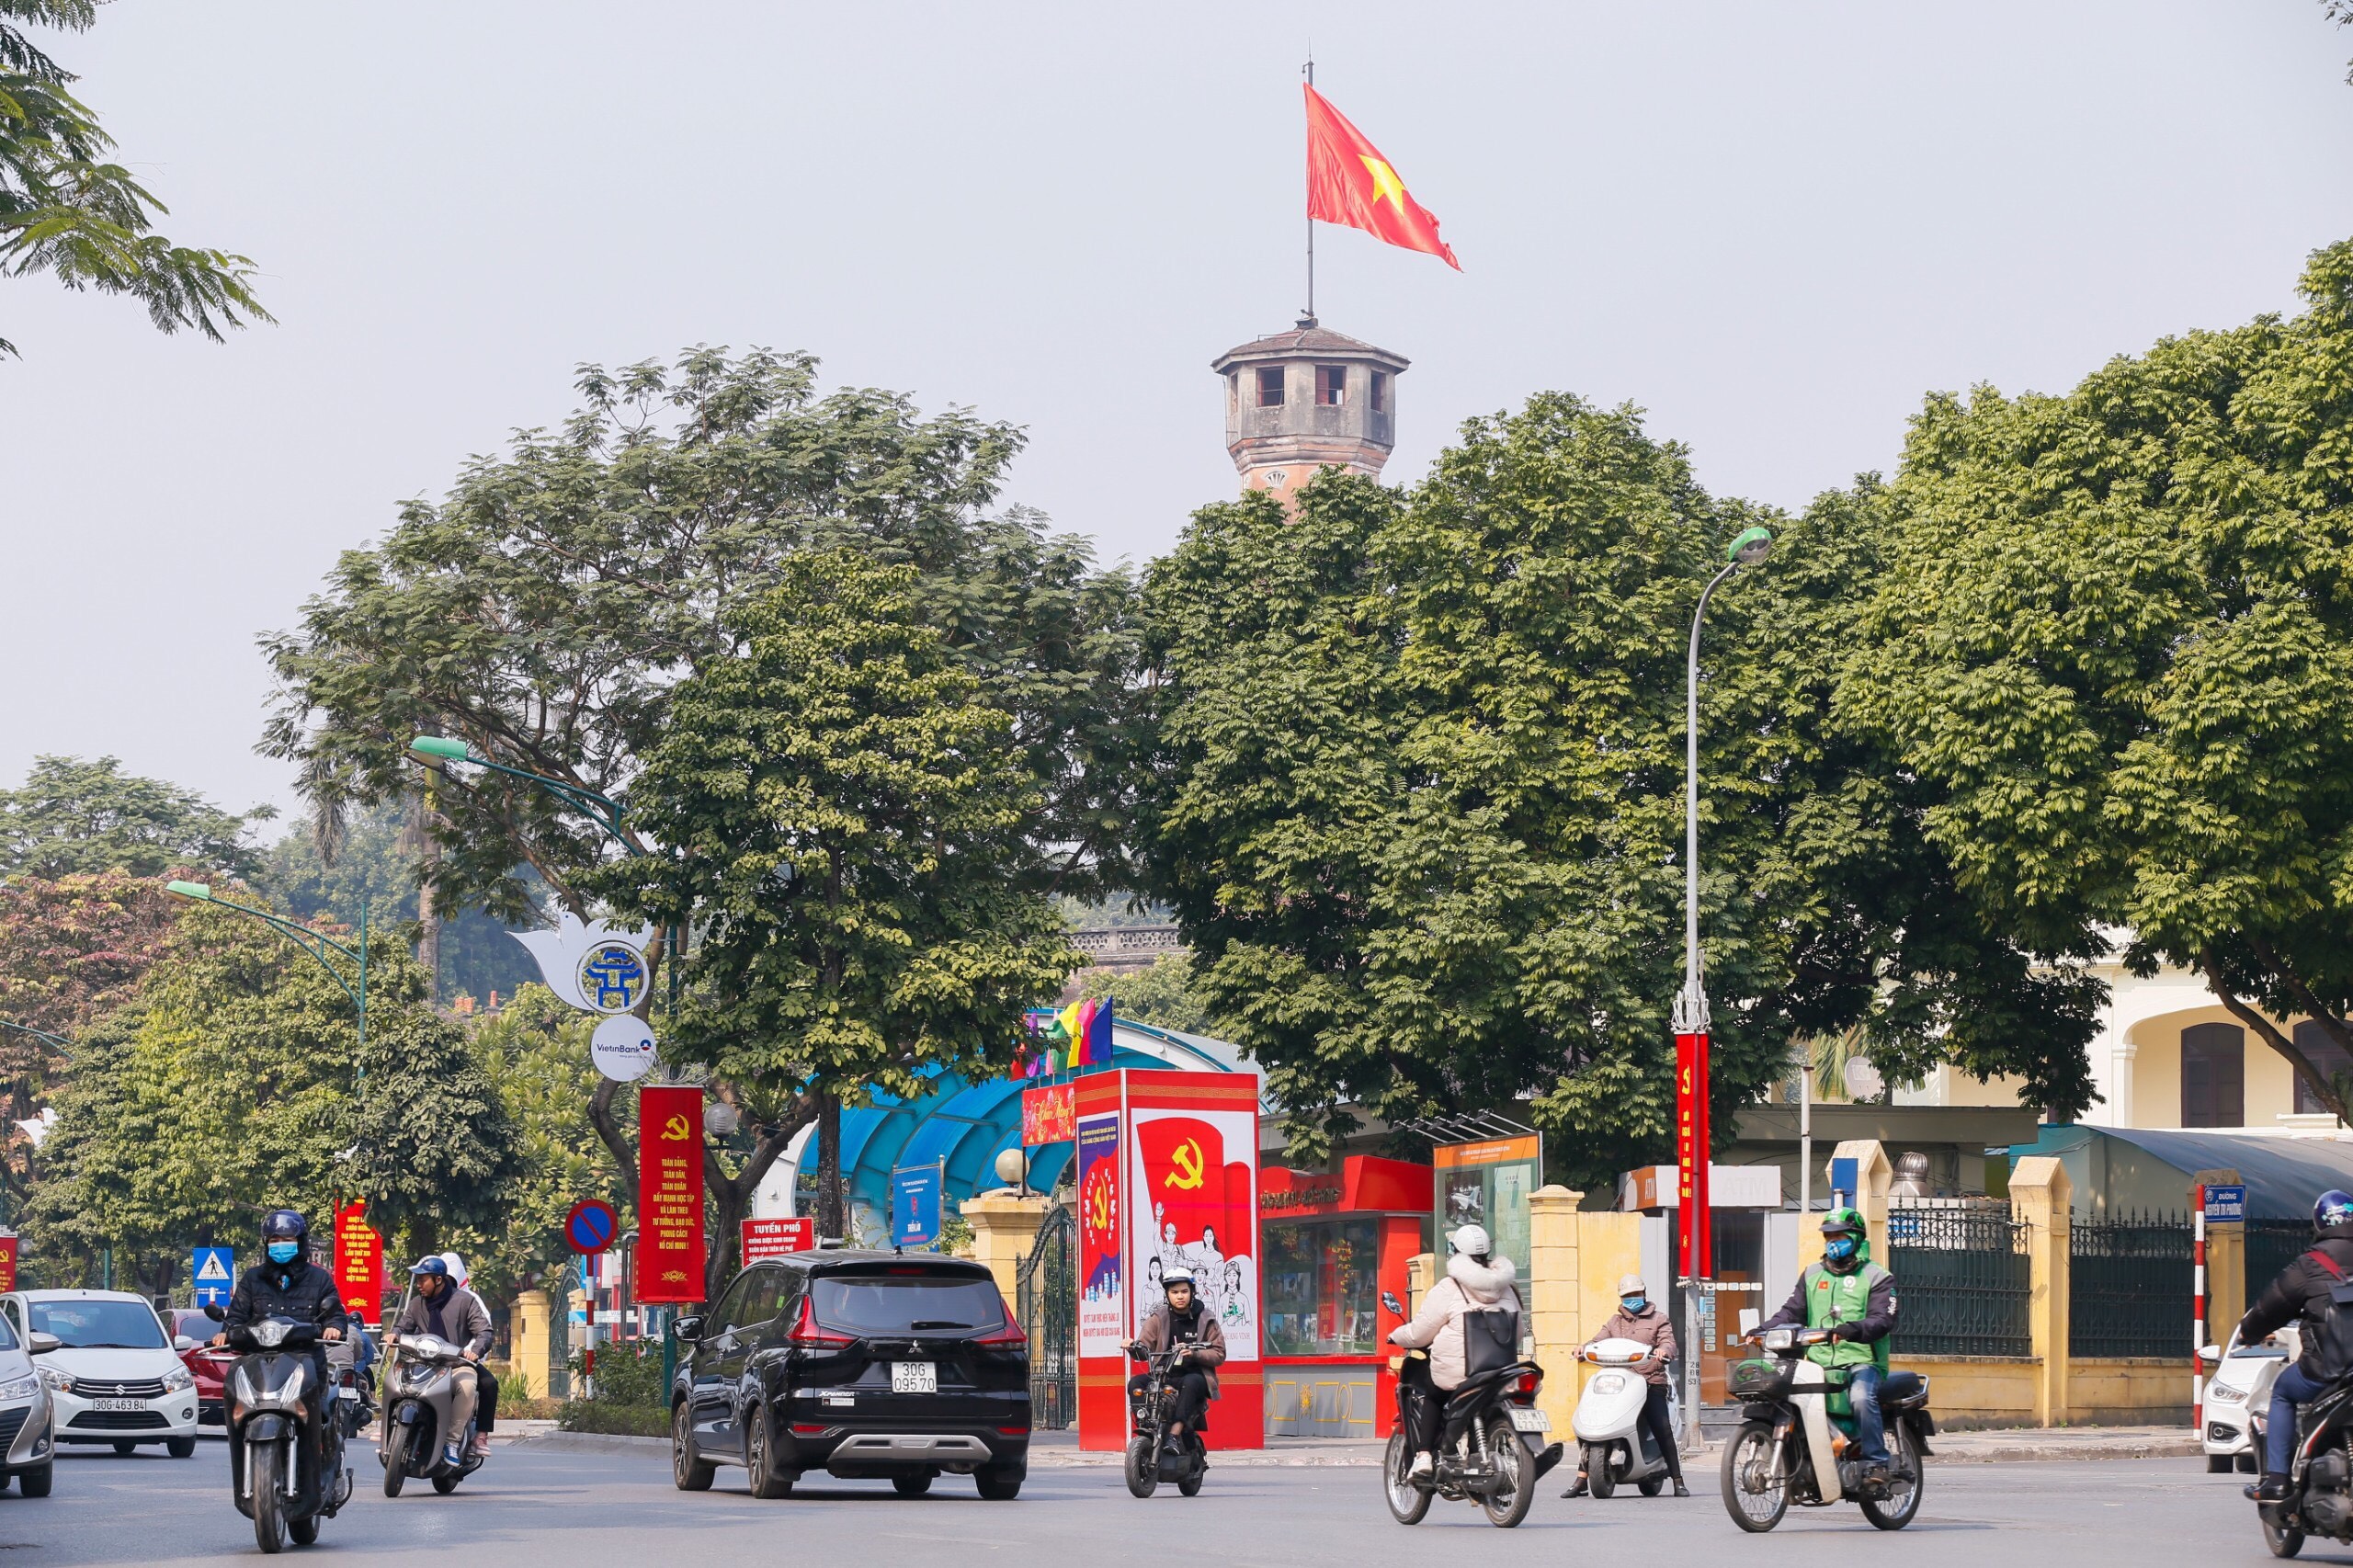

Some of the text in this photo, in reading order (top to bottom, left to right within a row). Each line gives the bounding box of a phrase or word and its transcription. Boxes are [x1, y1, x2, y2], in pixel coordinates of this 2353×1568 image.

[597, 1043, 641, 1052] VietinBank
[2218, 1192, 2237, 1200] ĐƯỜNG
[666, 1205, 676, 1214] LÀM
[677, 1206, 688, 1214] THEO
[754, 1221, 801, 1233] TUYẾN PHỐ
[660, 1229, 688, 1238] PHONG CÁCH
[665, 1241, 674, 1250] CHÍ
[675, 1242, 687, 1250] MINH
[903, 1363, 926, 1377] 30G
[894, 1378, 935, 1392] 095.70
[96, 1400, 144, 1411] 30G-463.84
